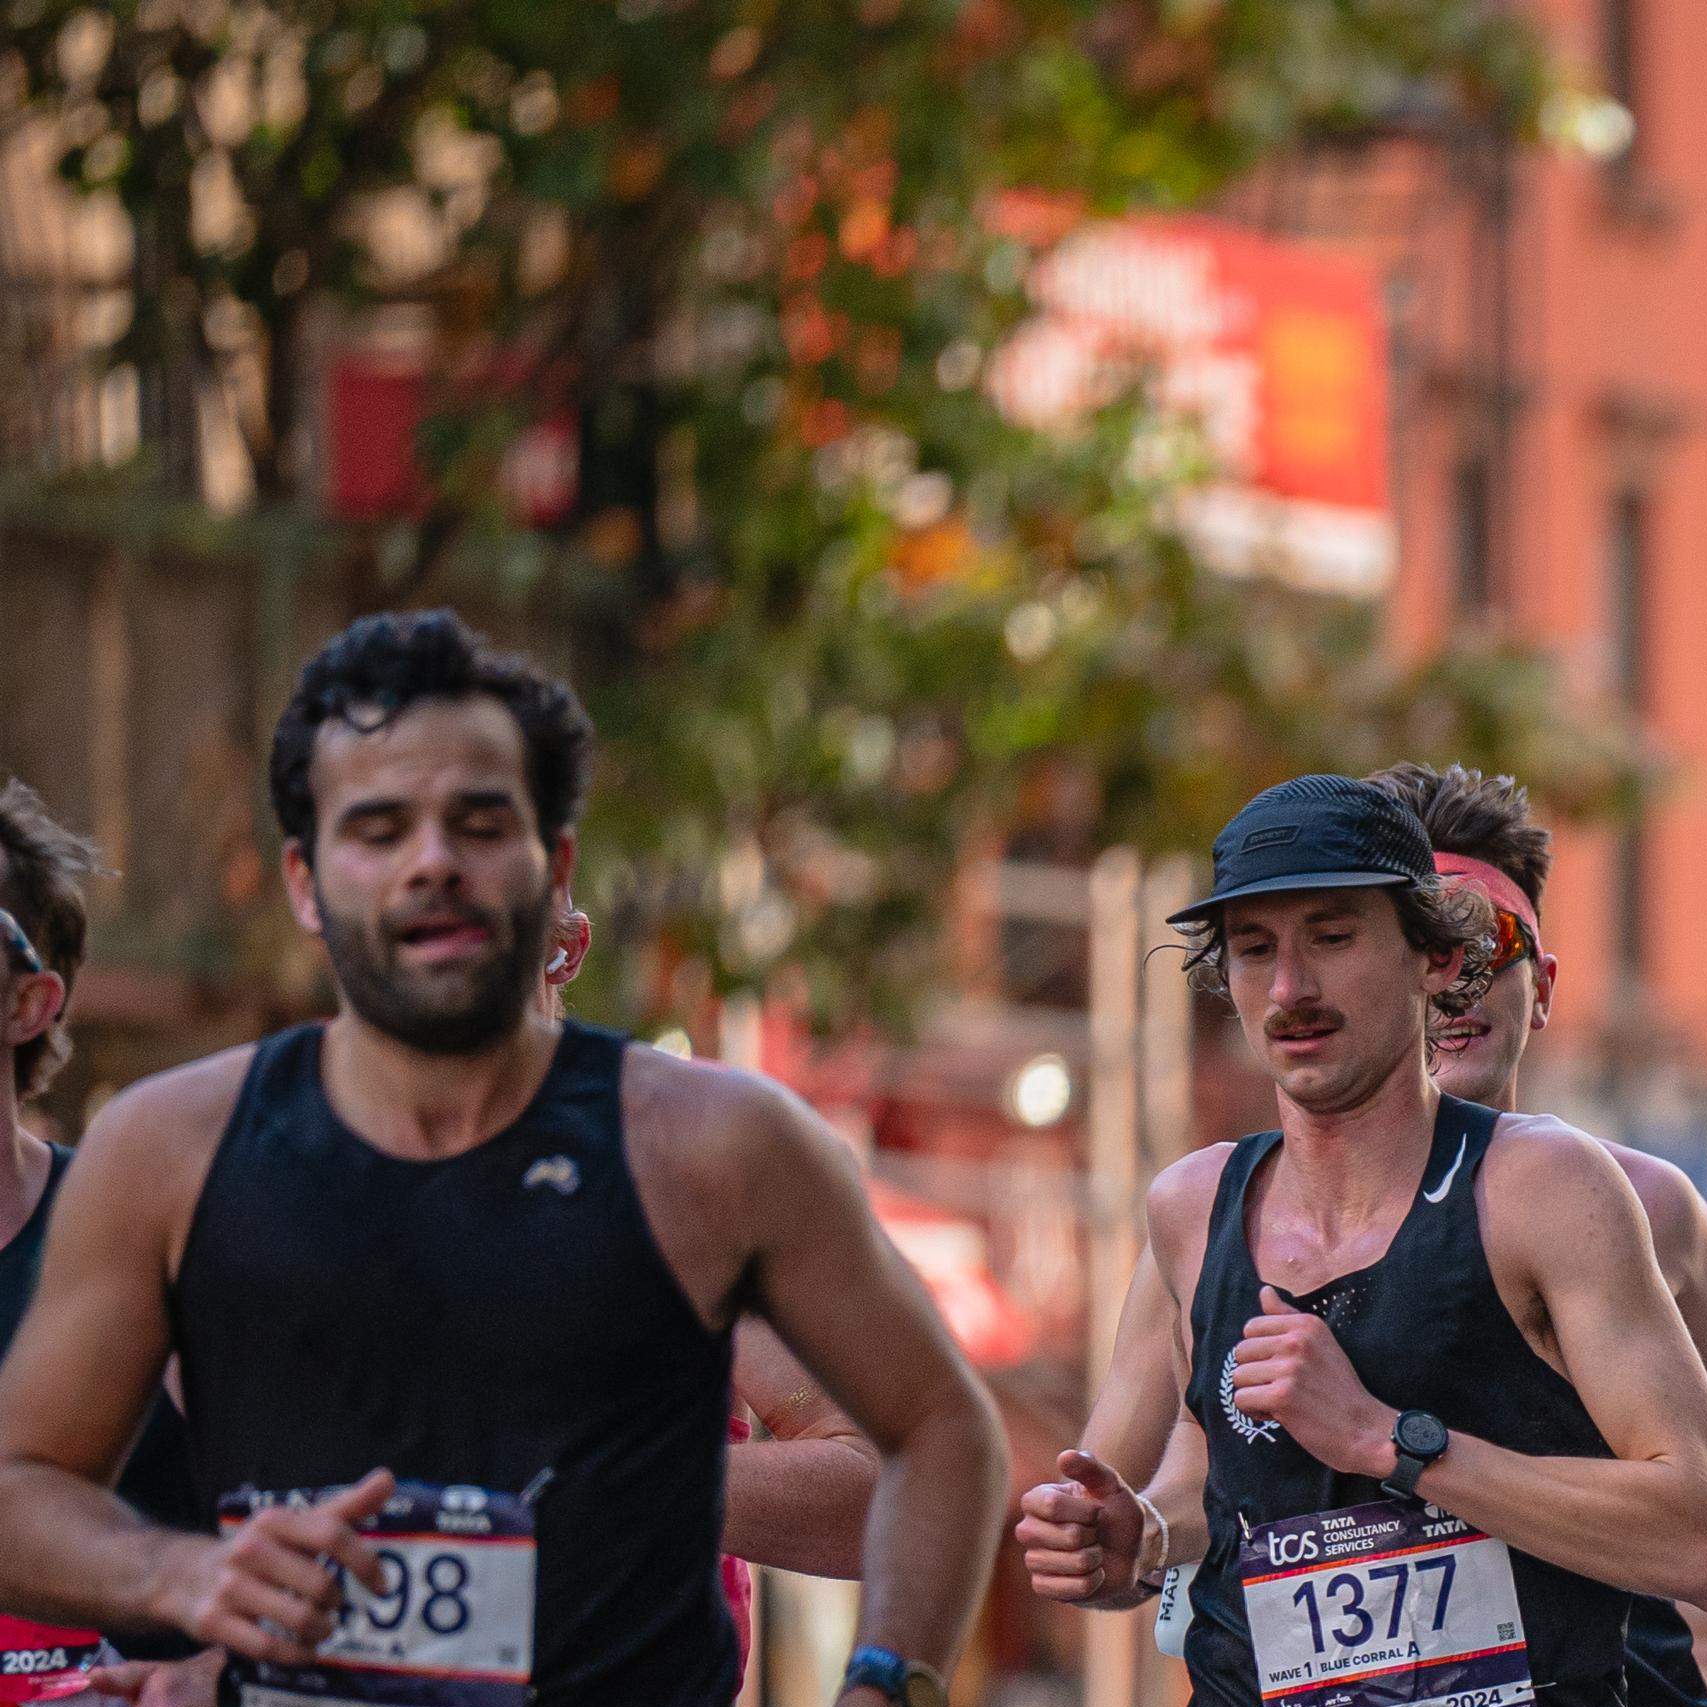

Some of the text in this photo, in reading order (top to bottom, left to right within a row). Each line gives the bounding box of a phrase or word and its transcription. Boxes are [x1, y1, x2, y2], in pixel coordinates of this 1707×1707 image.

[1321, 1516, 1356, 1530] TATA
[1323, 1520, 1400, 1543] CONSULTANCY
[1422, 1518, 1468, 1538] TATA
[1268, 1530, 1319, 1566] tcs
[1325, 1538, 1375, 1556] SERVICES
[1292, 1554, 1457, 1653] 1377
[3, 1648, 68, 1673] 2024
[1269, 1641, 1421, 1683] WAVE 1 BLUE CORRAL A
